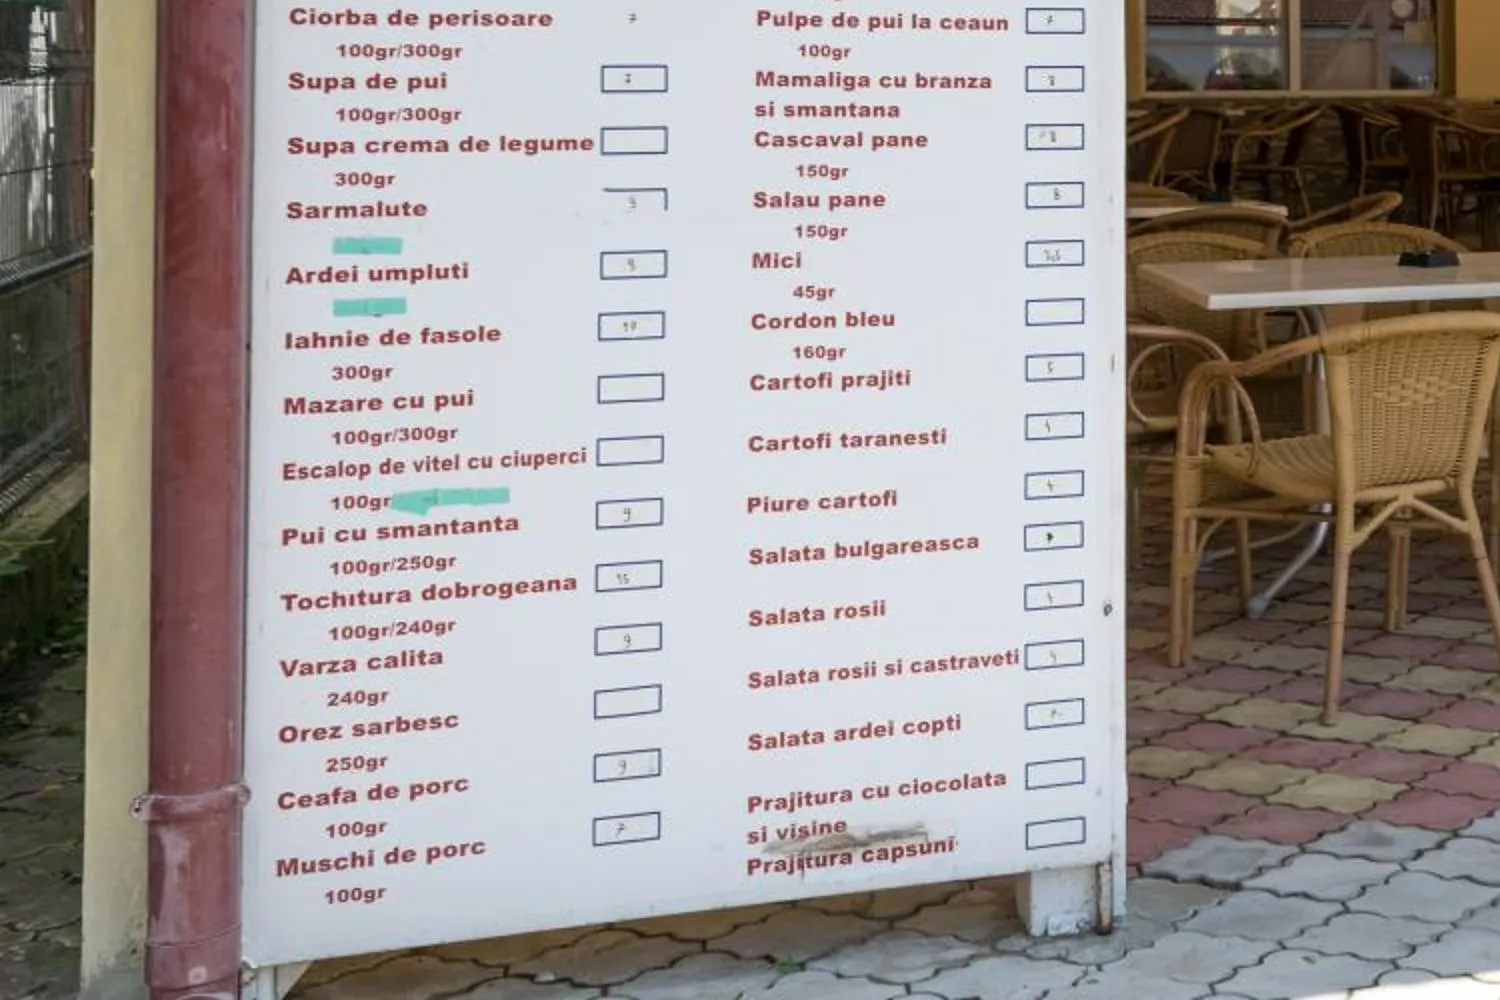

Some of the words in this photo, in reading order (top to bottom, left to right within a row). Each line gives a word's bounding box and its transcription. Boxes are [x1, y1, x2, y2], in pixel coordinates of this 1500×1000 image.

[288, 7, 378, 27] Ciorba
[386, 8, 420, 27] de
[428, 9, 554, 31] perisoare
[756, 9, 824, 32] Pulpe
[831, 11, 860, 29] de
[867, 13, 903, 33] pui
[911, 13, 932, 30] la
[939, 17, 1009, 31] ceaun
[335, 43, 463, 62] 100gr/300gr
[798, 43, 851, 62] 100gr
[287, 71, 356, 95] Supa
[365, 72, 399, 90] de
[407, 71, 447, 94] pui
[755, 70, 871, 92] Mamaliga
[879, 75, 907, 89] cu
[915, 72, 992, 89] branza
[334, 107, 462, 126] 100gr/300gr
[754, 100, 775, 118] si
[783, 102, 901, 119] smantana
[287, 136, 355, 159] Supa
[364, 139, 450, 154] crema
[458, 135, 491, 153] de
[499, 135, 595, 156] legume
[754, 130, 864, 149] Cascaval
[871, 135, 929, 152] pane
[334, 171, 396, 190] 300gr
[795, 164, 849, 181] 150gr
[286, 200, 428, 220] Sarmalute
[753, 191, 820, 209] Salau
[828, 194, 886, 212] pane
[794, 224, 849, 241] 150gr
[751, 251, 802, 269] Mici
[285, 264, 359, 286] Ardei
[368, 261, 469, 285] umpluti
[792, 285, 835, 302] 45gr
[751, 311, 837, 331] Cordon
[845, 311, 895, 328] bleu
[378, 328, 412, 347] de
[419, 325, 502, 345] fasole
[792, 345, 846, 361] 160gr
[331, 365, 393, 383] 300gr
[749, 371, 833, 392] Cartofi
[841, 369, 911, 392] prajiti
[283, 396, 384, 416] Mazare
[392, 395, 425, 410] cu
[433, 388, 474, 413] pui
[331, 426, 459, 448] 100gr/300gr
[748, 432, 832, 453] Cartofi
[839, 427, 947, 449] taranesti
[282, 459, 372, 481] Escalop
[378, 457, 406, 476] de
[412, 453, 460, 473] vitel
[467, 455, 494, 470] cu
[500, 449, 587, 471] ciuperci
[330, 495, 393, 512] 100gr
[747, 494, 810, 514] Piure
[817, 489, 897, 510] cartofi
[281, 526, 325, 547] Pui
[333, 527, 367, 543] cu
[376, 515, 519, 541] smantanta
[749, 545, 826, 566] Salata
[834, 536, 980, 561] bulgareasca
[329, 555, 457, 577] 100gr/250gr
[279, 589, 412, 612] Tochitura
[420, 577, 577, 602] dobrogeana
[748, 606, 826, 627] Salata
[833, 599, 886, 620] rosii
[328, 619, 457, 642] 100gr/240gr
[279, 658, 357, 679] Varza
[366, 649, 444, 671] calita
[747, 668, 820, 690] Salata
[827, 660, 877, 682] rosii
[884, 657, 903, 677] si
[909, 647, 1020, 674] castraveti
[327, 689, 389, 707] 240gr
[277, 725, 343, 744] Orez
[351, 714, 459, 738] sarbesc
[747, 729, 825, 751] Salata
[833, 720, 895, 743] ardei
[902, 713, 961, 737] copti
[325, 755, 389, 773] 250gr
[276, 786, 358, 811] Ceafa
[366, 782, 400, 802] de
[409, 778, 469, 802] porc
[747, 789, 853, 814] Prajitura
[861, 785, 890, 801] cu
[897, 771, 1007, 797] ciocolata
[325, 821, 387, 839] 100gr
[747, 825, 768, 845] si
[776, 819, 849, 842] visine
[275, 849, 375, 878] Muschi
[383, 845, 417, 866] de
[425, 841, 486, 865] porc
[747, 851, 854, 877] Prajitura
[861, 834, 957, 865] capsuni
[324, 887, 387, 905] 100gr
